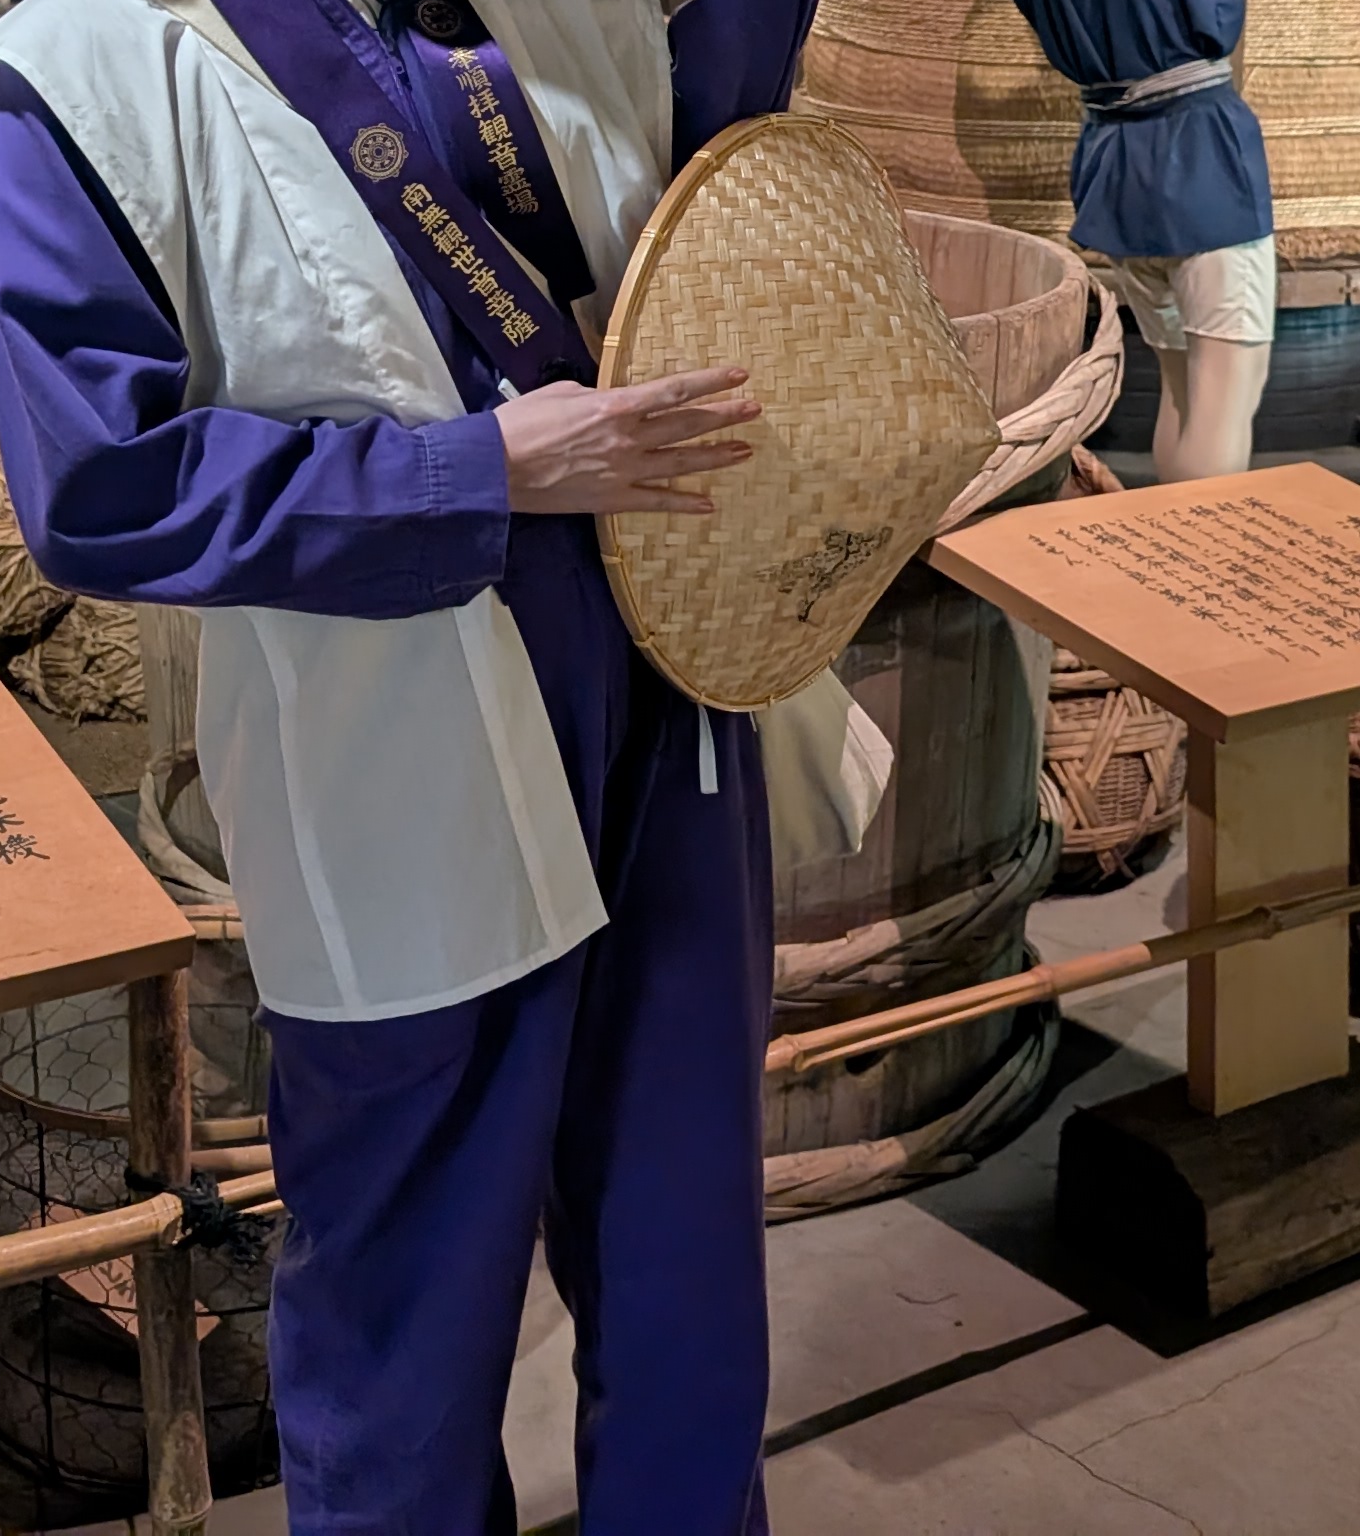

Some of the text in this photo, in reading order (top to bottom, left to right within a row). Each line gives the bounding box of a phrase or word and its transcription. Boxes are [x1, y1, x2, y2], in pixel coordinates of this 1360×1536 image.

[401, 182, 540, 348] 南無観世音菩薩
